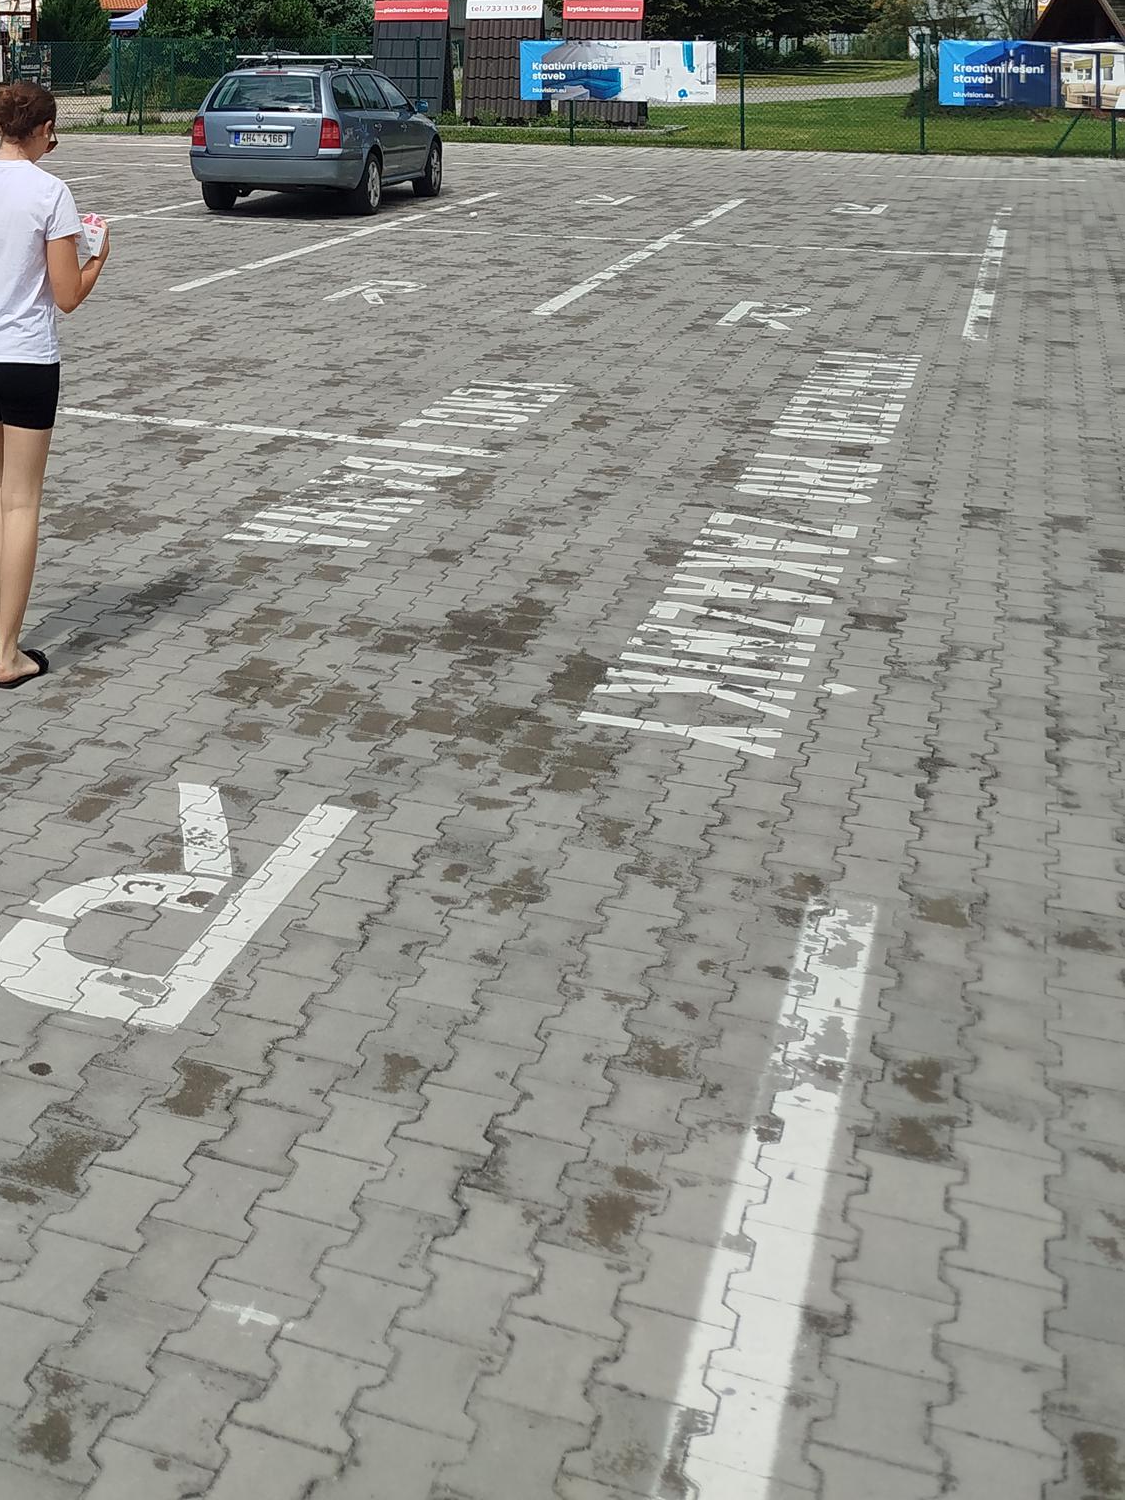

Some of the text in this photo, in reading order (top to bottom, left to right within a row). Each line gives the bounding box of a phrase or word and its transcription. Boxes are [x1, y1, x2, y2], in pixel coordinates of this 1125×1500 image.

[532, 61, 576, 71] Kreativní
[953, 63, 1045, 74] Kreativní řešení
[532, 72, 566, 81] staveb
[953, 75, 993, 84] staveb
[952, 91, 995, 99] bluvision.eu
[262, 133, 283, 143] 4166
[770, 350, 923, 445] VYHRAZENO
[733, 453, 884, 505] PRO
